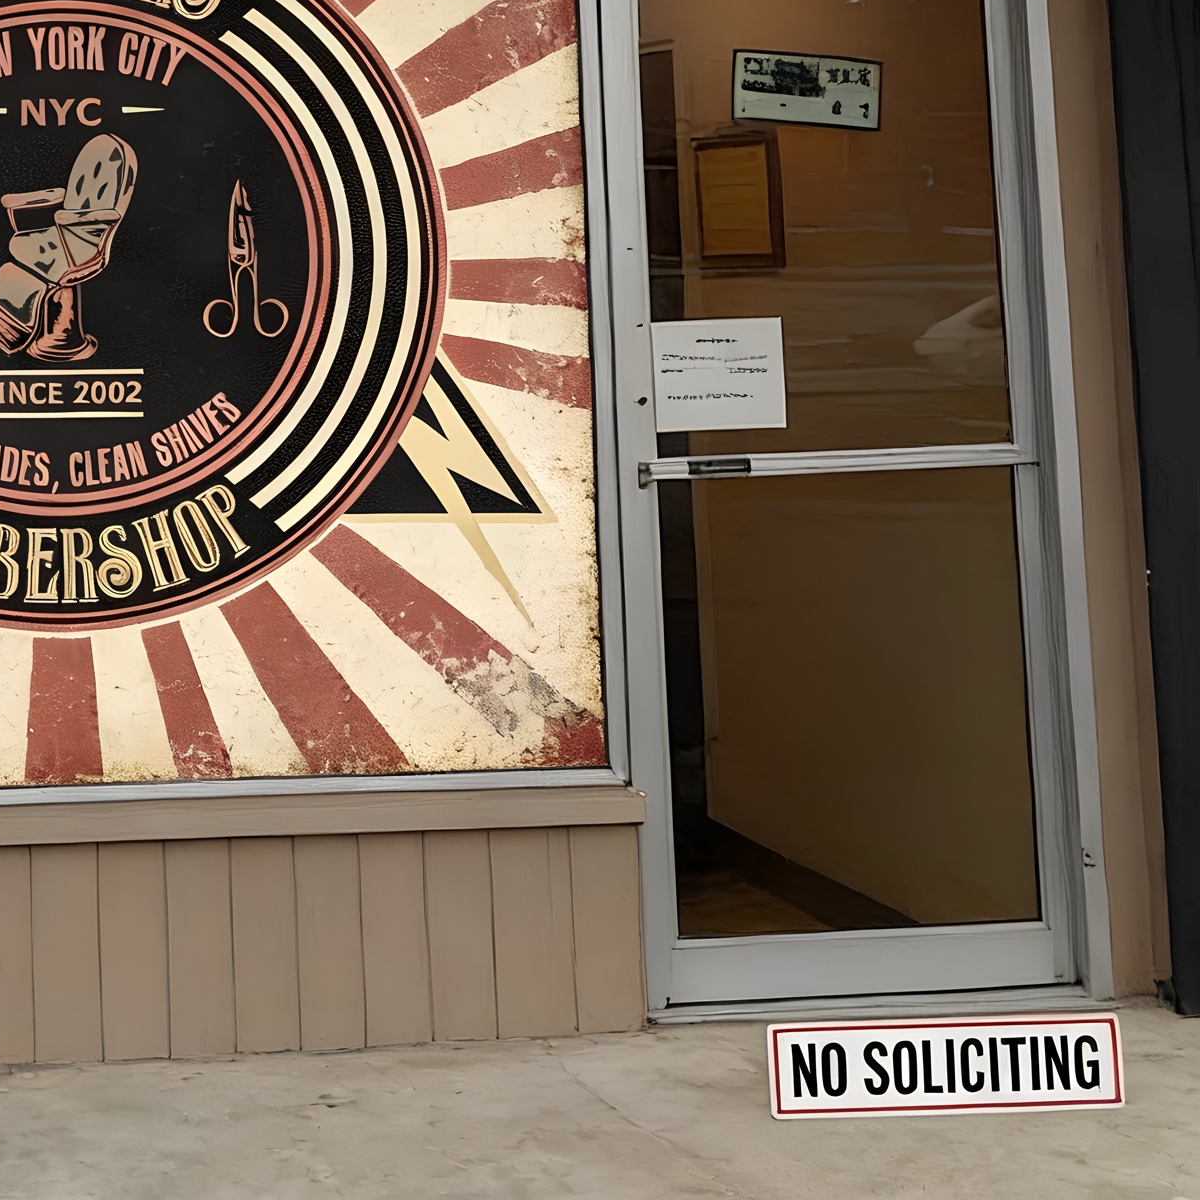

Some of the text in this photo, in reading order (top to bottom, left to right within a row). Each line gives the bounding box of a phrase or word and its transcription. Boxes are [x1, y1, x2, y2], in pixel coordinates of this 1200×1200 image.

[26, 25, 107, 72] YORK
[117, 31, 190, 87] CITY
[20, 97, 102, 127] NYC
[72, 380, 143, 404] 2002
[68, 440, 149, 488] CLEAN
[150, 391, 242, 468] SHAVES
[790, 1034, 1101, 1098] NO SOLICITING
